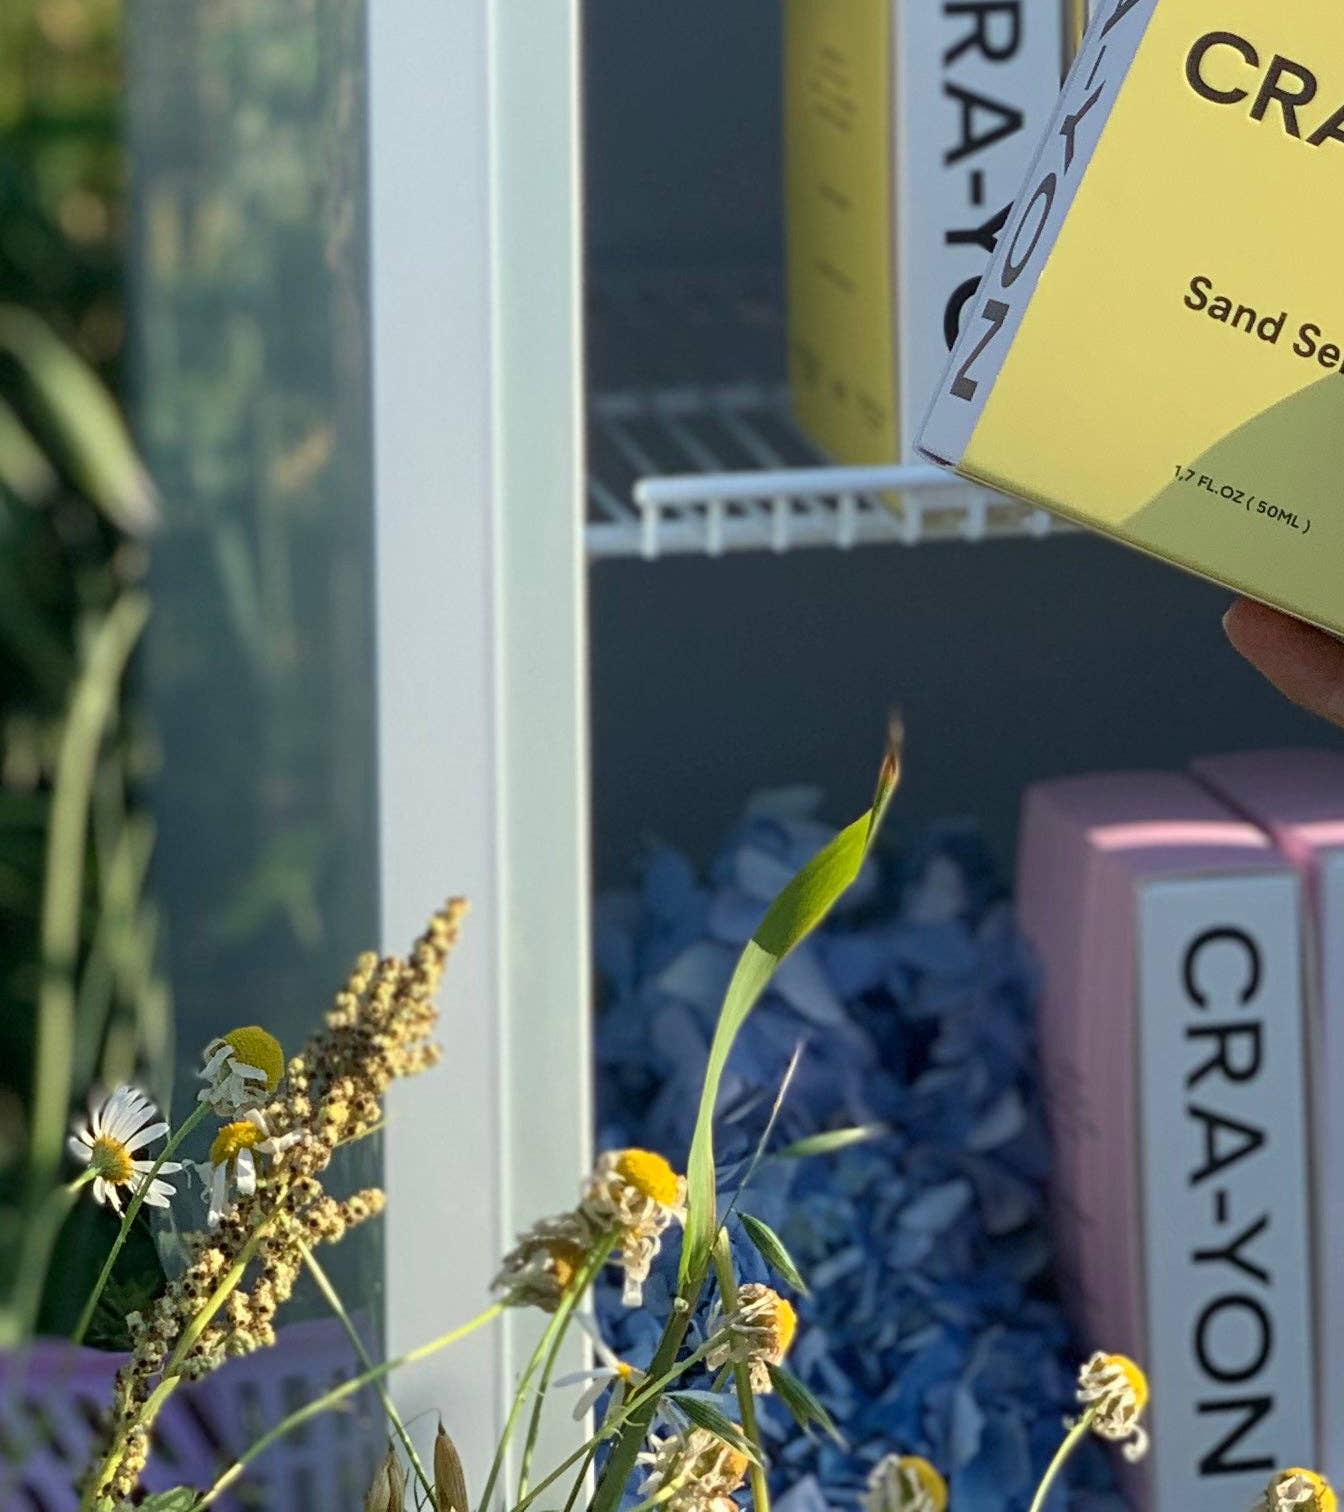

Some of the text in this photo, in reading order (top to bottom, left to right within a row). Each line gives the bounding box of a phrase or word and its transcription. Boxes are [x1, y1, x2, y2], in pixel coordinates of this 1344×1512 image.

[1183, 275, 1286, 345] Sand
[1175, 465, 1196, 482] 1,7
[1197, 474, 1246, 504] FL.OZ
[1182, 927, 1278, 1478] CRA-YON
